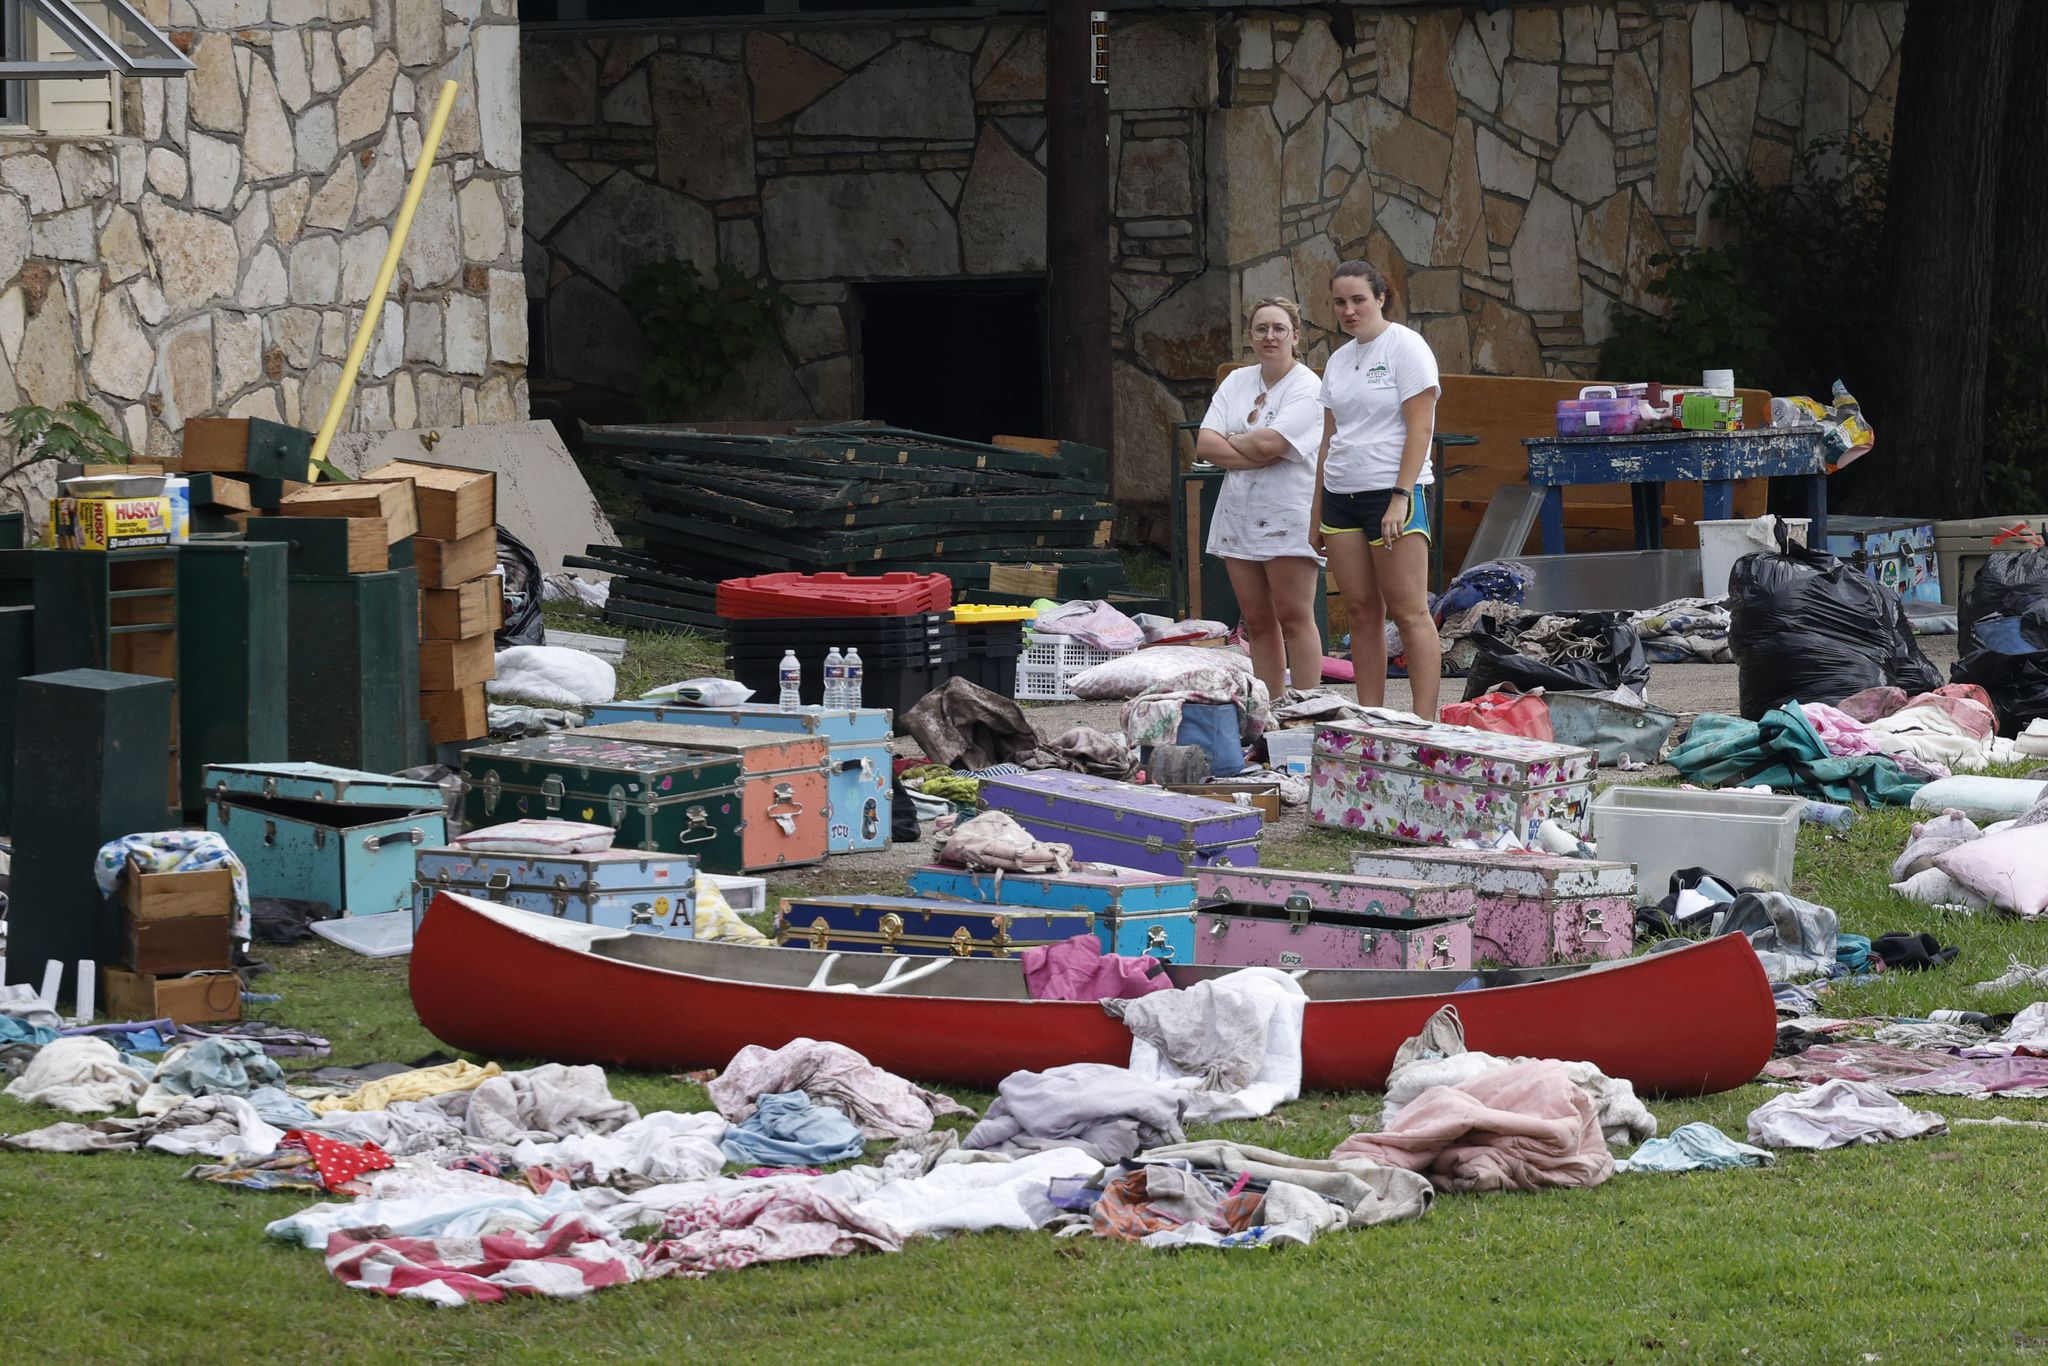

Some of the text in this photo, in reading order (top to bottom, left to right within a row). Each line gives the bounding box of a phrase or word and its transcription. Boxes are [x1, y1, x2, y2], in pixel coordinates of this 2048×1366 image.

[115, 501, 161, 520] HUSKY
[94, 502, 105, 545] HUSKY
[831, 825, 849, 838] TCU
[670, 898, 691, 926] A
[1280, 953, 1302, 965] Kate
